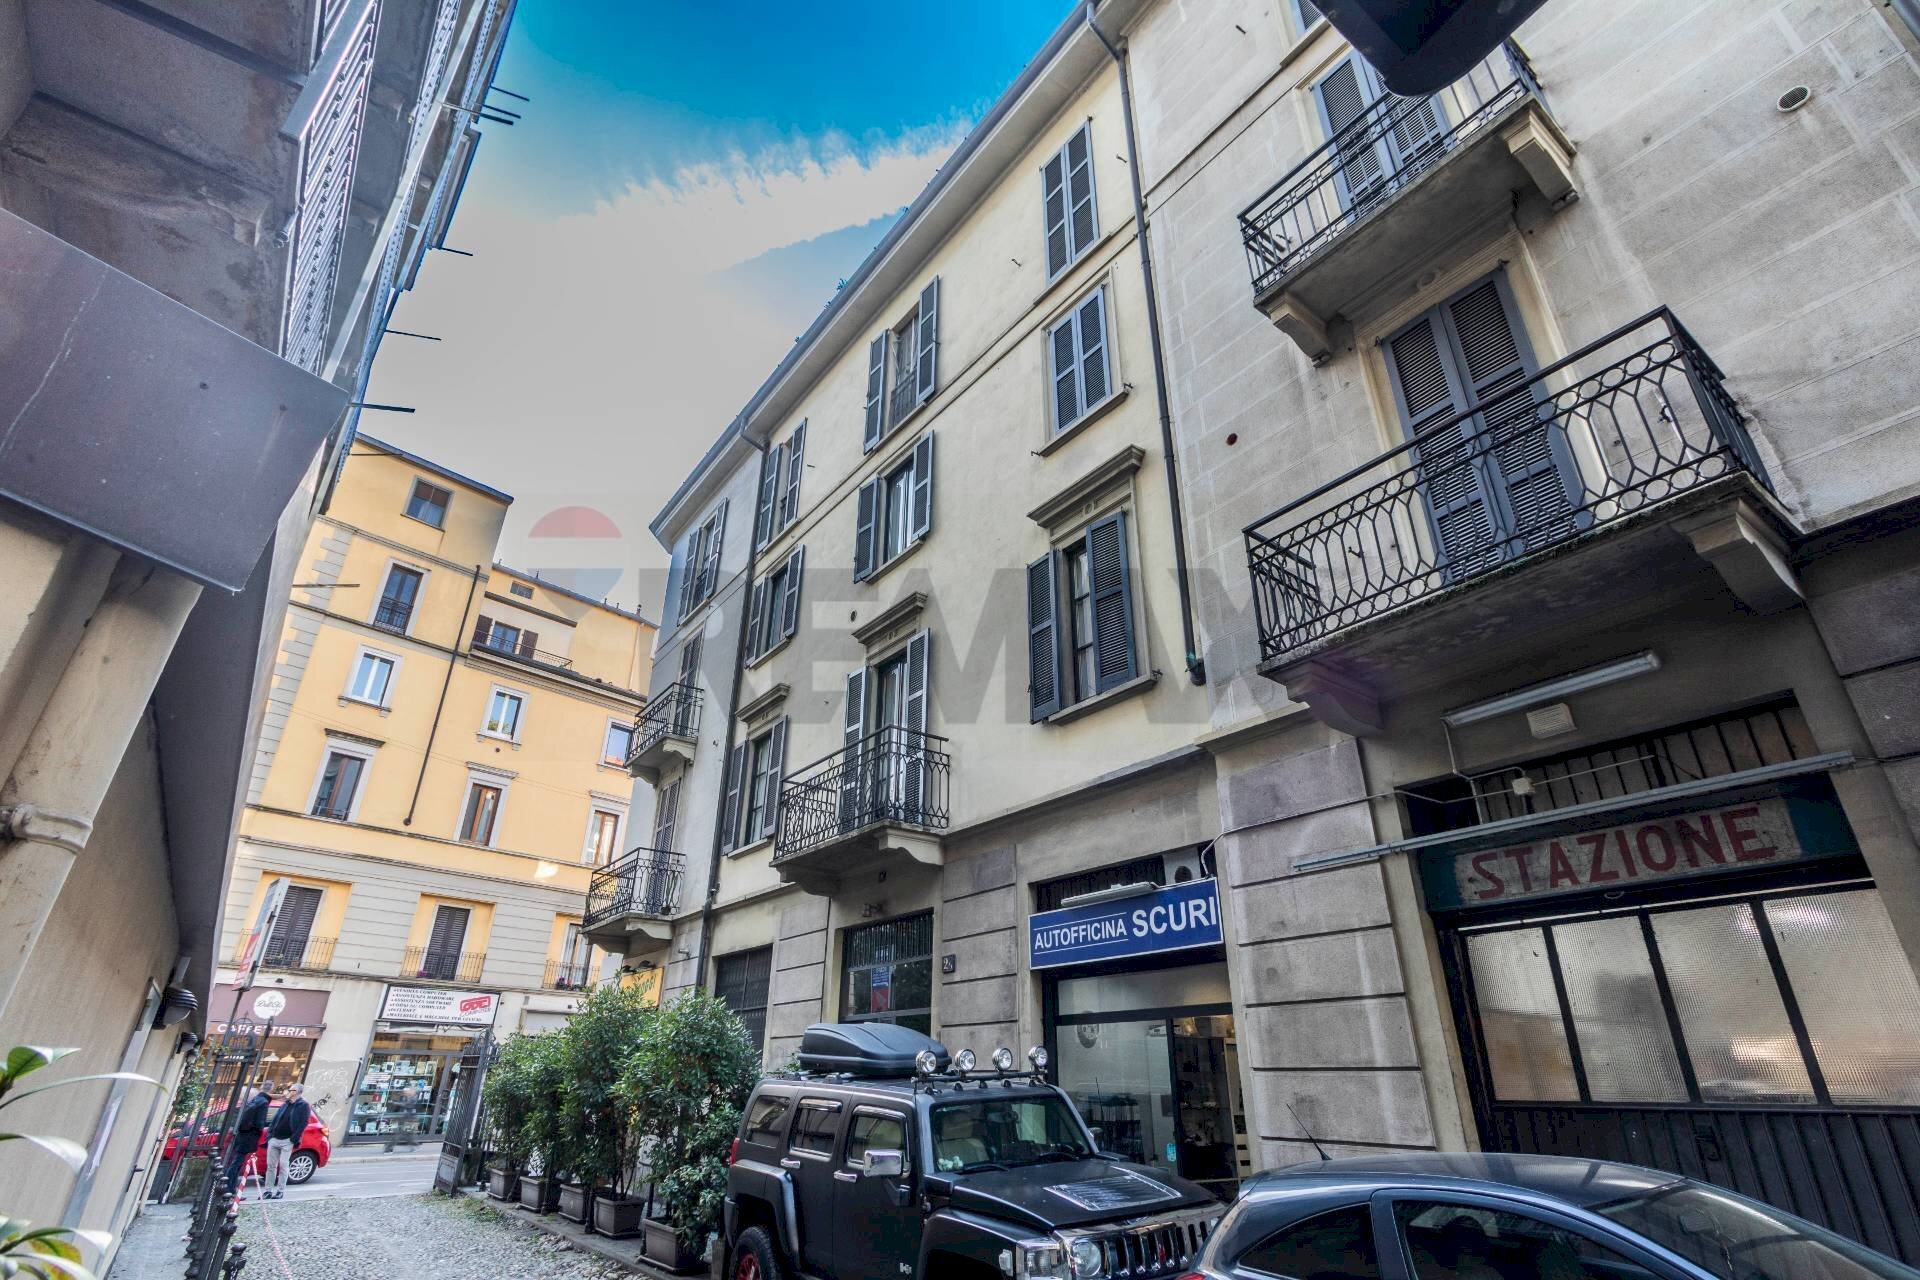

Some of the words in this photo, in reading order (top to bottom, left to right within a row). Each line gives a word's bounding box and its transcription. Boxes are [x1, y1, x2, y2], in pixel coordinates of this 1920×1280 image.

[1471, 807, 1778, 900] STAZIONE
[1034, 918, 1128, 950] AUTOFFICINA
[1132, 896, 1217, 937] SCURI
[217, 1023, 307, 1037] CFFETERIA
